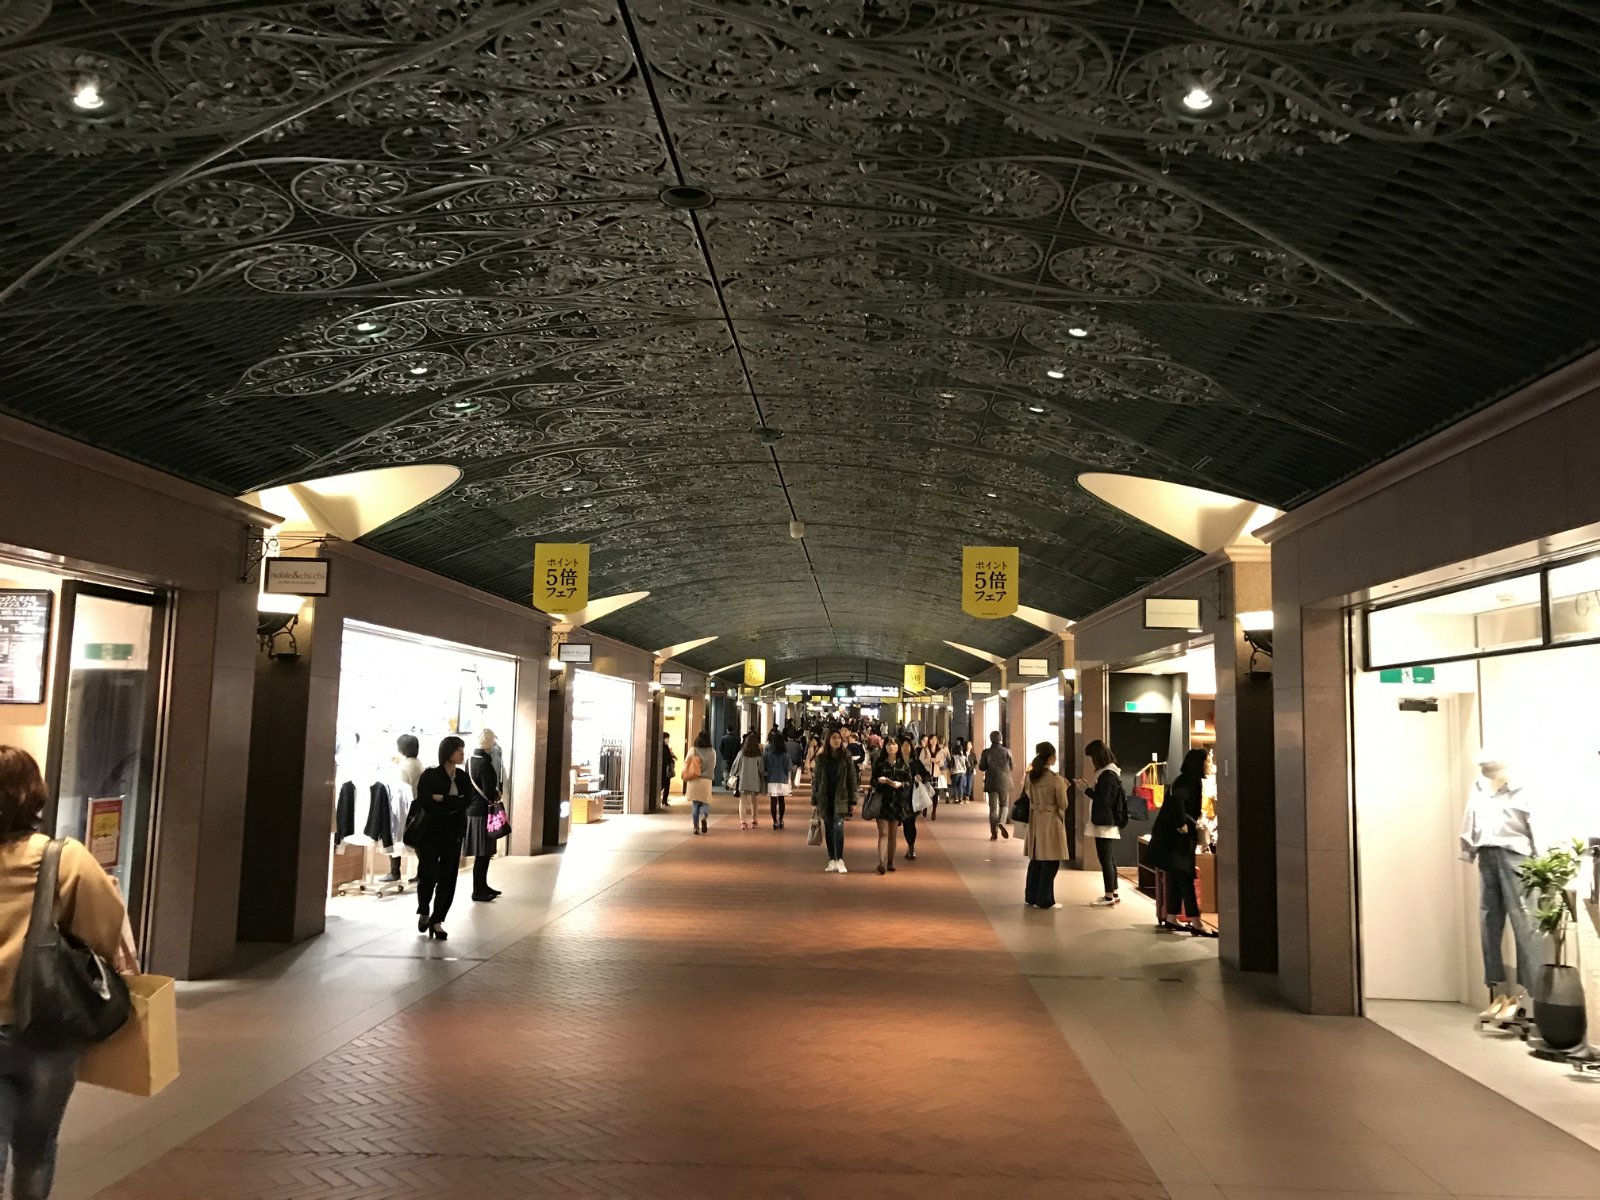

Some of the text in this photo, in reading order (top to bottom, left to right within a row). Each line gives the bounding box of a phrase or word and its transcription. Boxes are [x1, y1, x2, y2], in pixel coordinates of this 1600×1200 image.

[547, 558, 579, 569] ポイント
[975, 561, 1008, 570] ポイント
[546, 568, 578, 586] 5倍
[975, 571, 1007, 589] 5倍
[546, 587, 578, 599] フェア
[974, 590, 1007, 603] フェア
